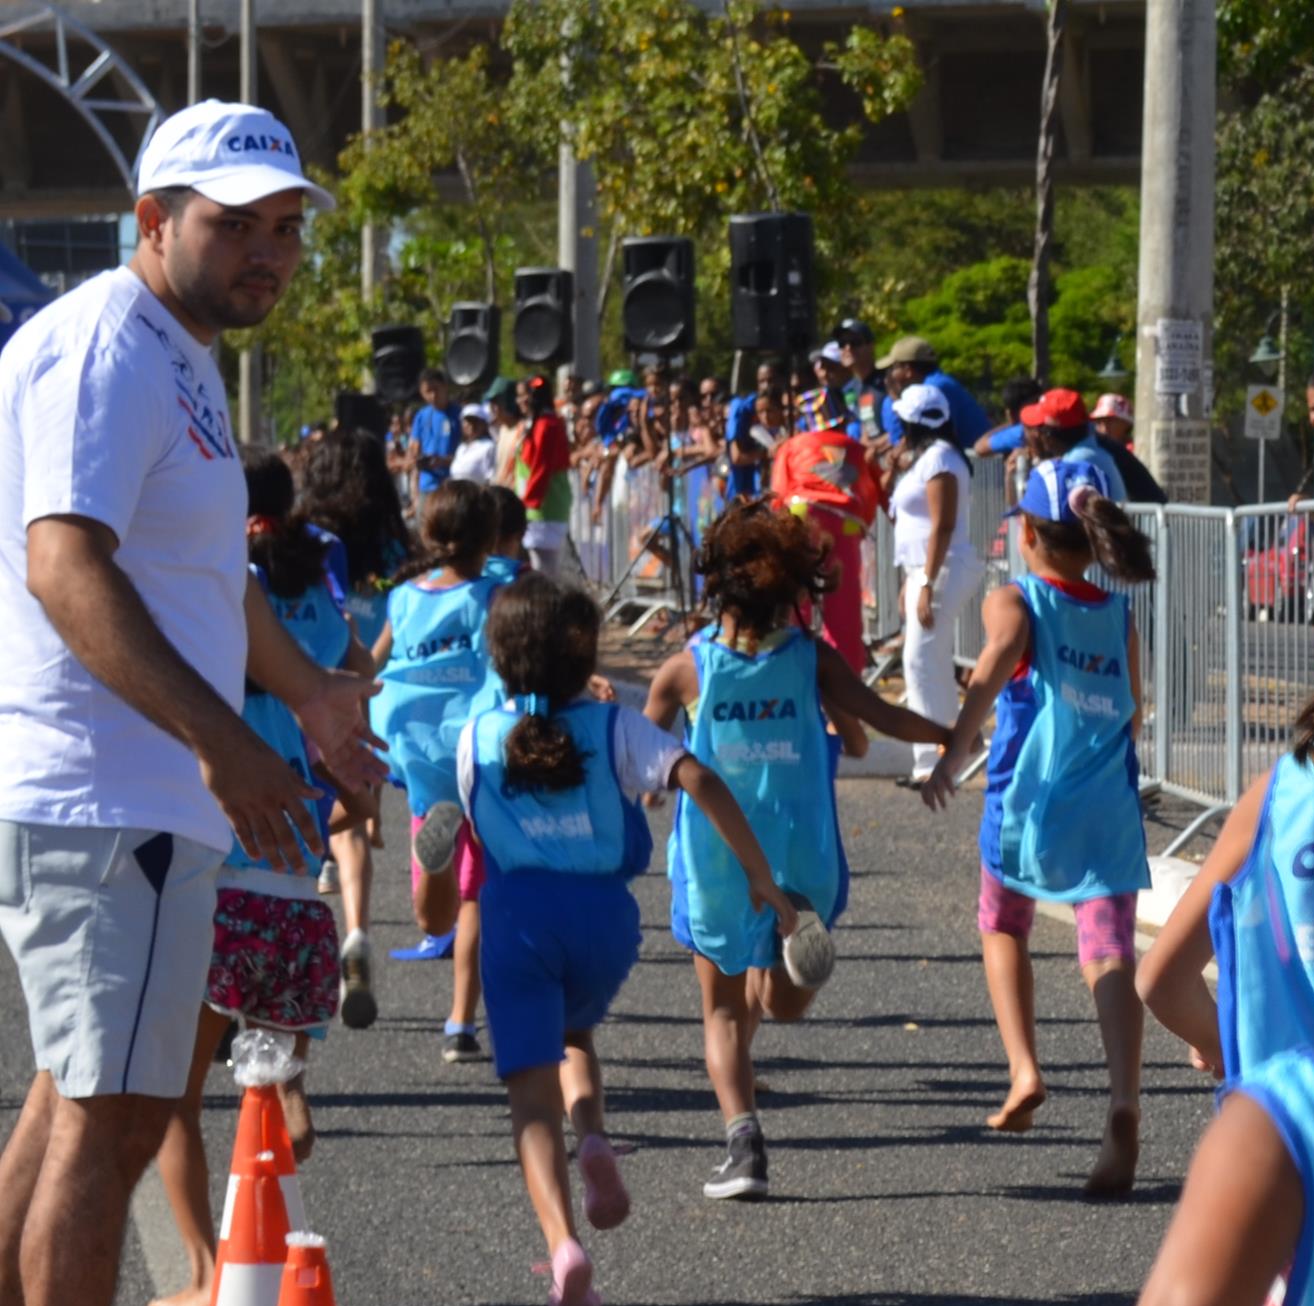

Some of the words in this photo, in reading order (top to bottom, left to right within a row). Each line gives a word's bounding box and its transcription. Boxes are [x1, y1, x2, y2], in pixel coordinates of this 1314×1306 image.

[227, 134, 295, 158] CAIXA
[406, 633, 473, 661] CAIXA
[1057, 644, 1121, 677] CAIXA
[712, 698, 798, 722] CAIXA
